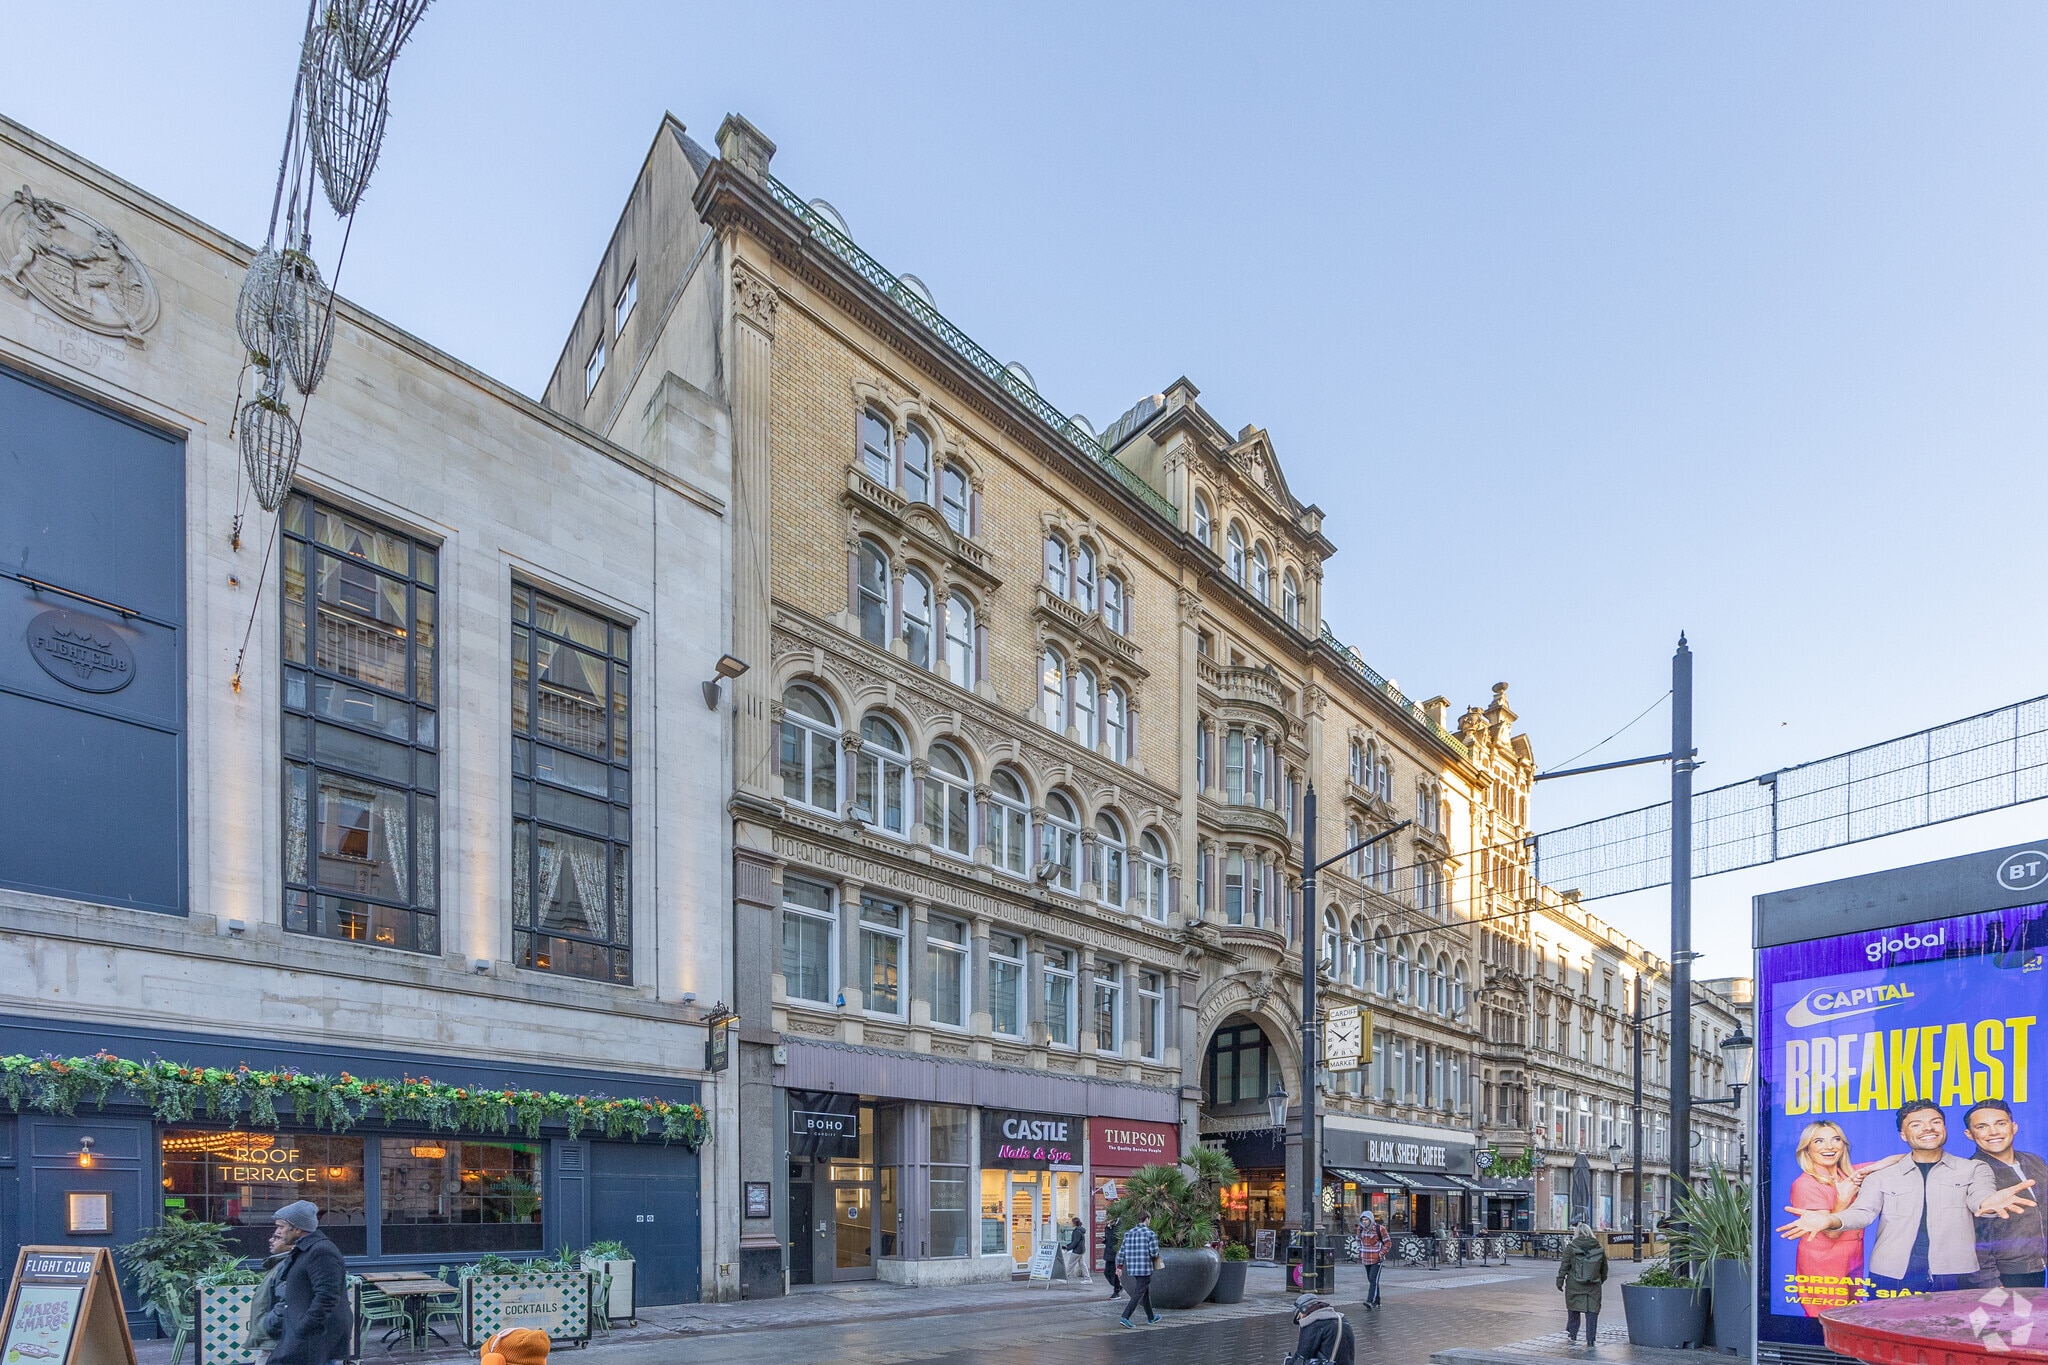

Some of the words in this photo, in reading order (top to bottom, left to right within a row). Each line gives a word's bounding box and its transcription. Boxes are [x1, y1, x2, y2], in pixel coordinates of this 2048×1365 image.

[58, 339, 101, 369] 1857
[35, 637, 87, 661] FLIGHT
[92, 653, 127, 671] CLUB
[2009, 860, 2041, 880] BT
[1866, 927, 1946, 962] global
[1813, 982, 1915, 1011] CAPITAL
[1201, 985, 1241, 1028] MARKET
[1330, 1008, 1357, 1018] CARDIFF
[1330, 1059, 1355, 1068] MARKET
[1785, 1016, 2037, 1116] BREAKFAST
[807, 1119, 843, 1131] BOHO
[1002, 1118, 1068, 1142] CASTLE
[1104, 1129, 1166, 1147] TIMPSON
[236, 1149, 300, 1164] ROOF
[998, 1145, 1031, 1159] Nails
[1033, 1147, 1046, 1160] &
[1047, 1148, 1071, 1164] Spa
[1369, 1140, 1395, 1163] BLACK
[1397, 1143, 1419, 1165] SHEEP
[1421, 1145, 1446, 1167] COFFEE
[219, 1166, 317, 1182] TERRACE
[25, 1260, 63, 1273] FLIGHT
[64, 1260, 92, 1273] CLUB
[1784, 1274, 1877, 1288] JORDAN,
[1784, 1285, 1849, 1296] CHRIS
[1854, 1288, 1870, 1298] &
[21, 1301, 69, 1319] MARGS
[505, 1302, 558, 1316] COCKTAILS
[1785, 1296, 1863, 1307] WEEKDA
